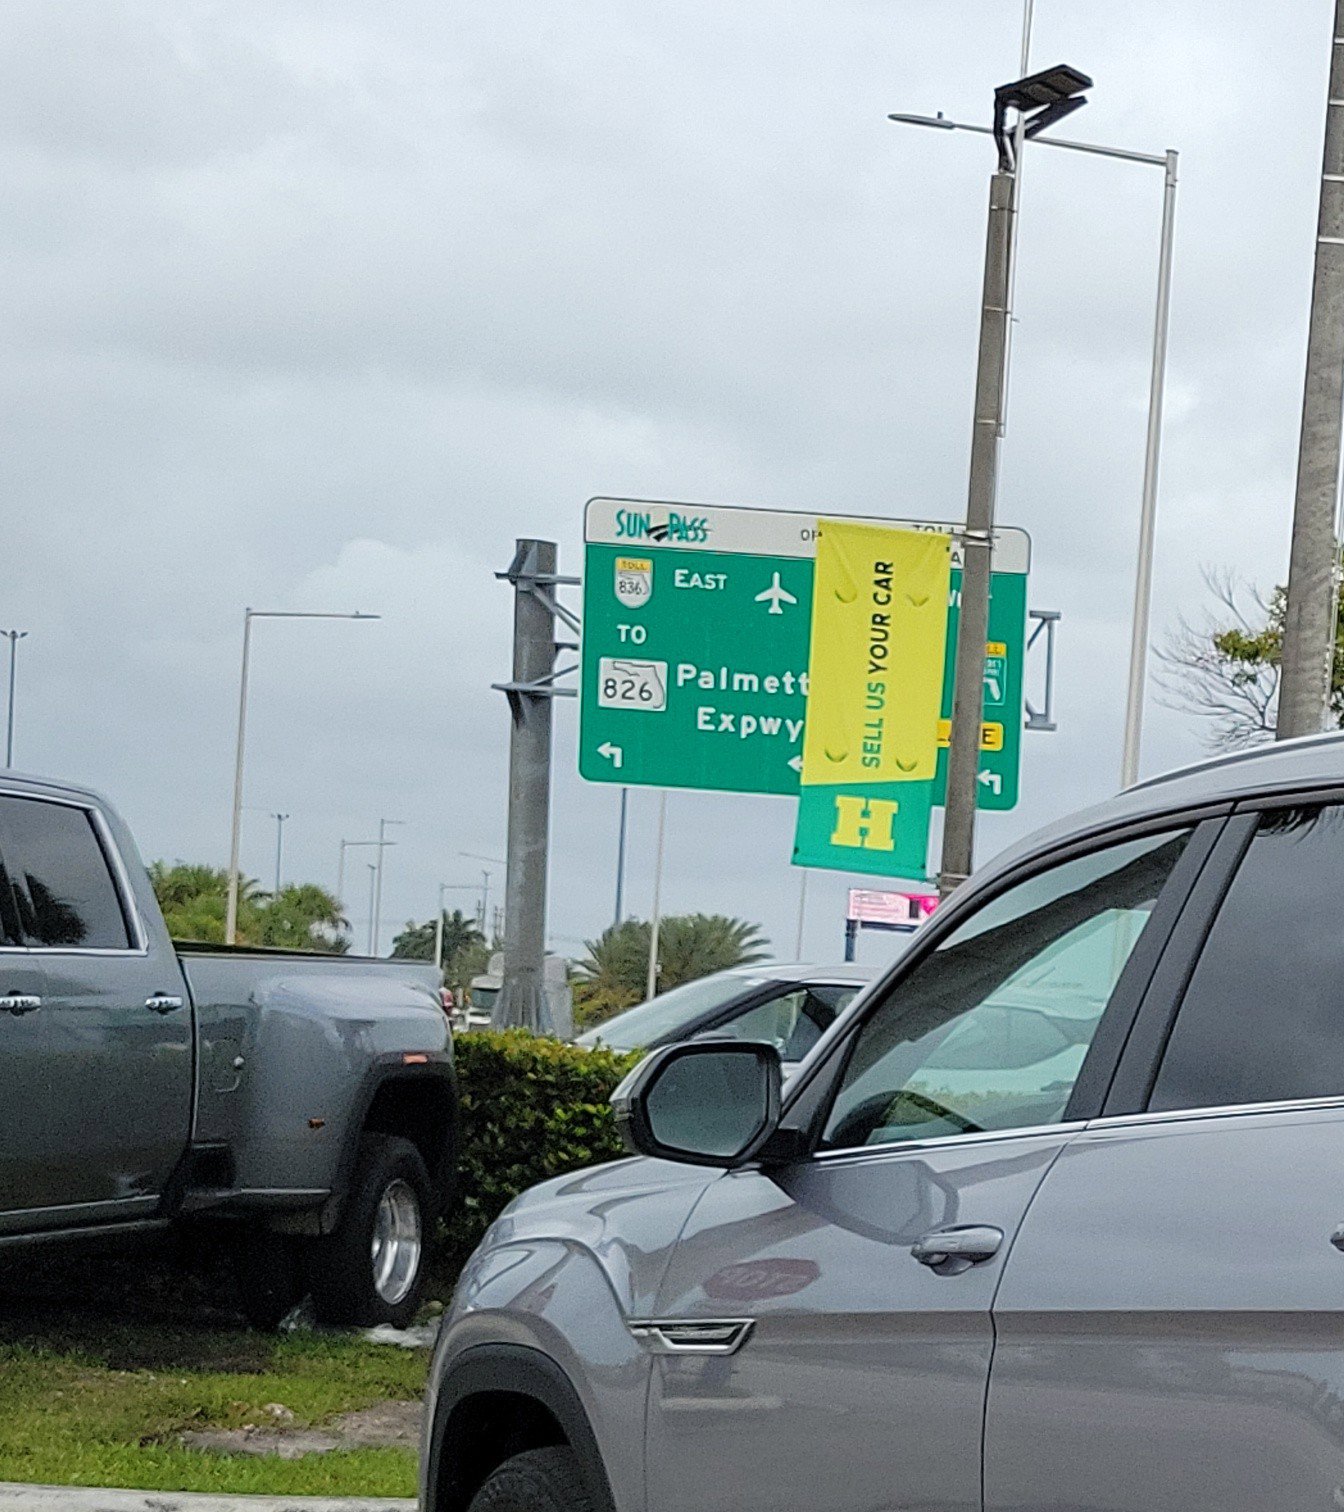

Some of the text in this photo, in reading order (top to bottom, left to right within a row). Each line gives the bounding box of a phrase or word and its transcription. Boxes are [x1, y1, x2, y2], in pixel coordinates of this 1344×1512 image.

[618, 579, 643, 595] 836
[674, 569, 728, 590] EAST
[616, 624, 647, 644] TO
[861, 561, 894, 769] SELL US YOUR CAR
[604, 678, 653, 701] 826
[676, 663, 810, 696] Palmett
[697, 706, 805, 743] Expwy
[830, 794, 899, 851] H
